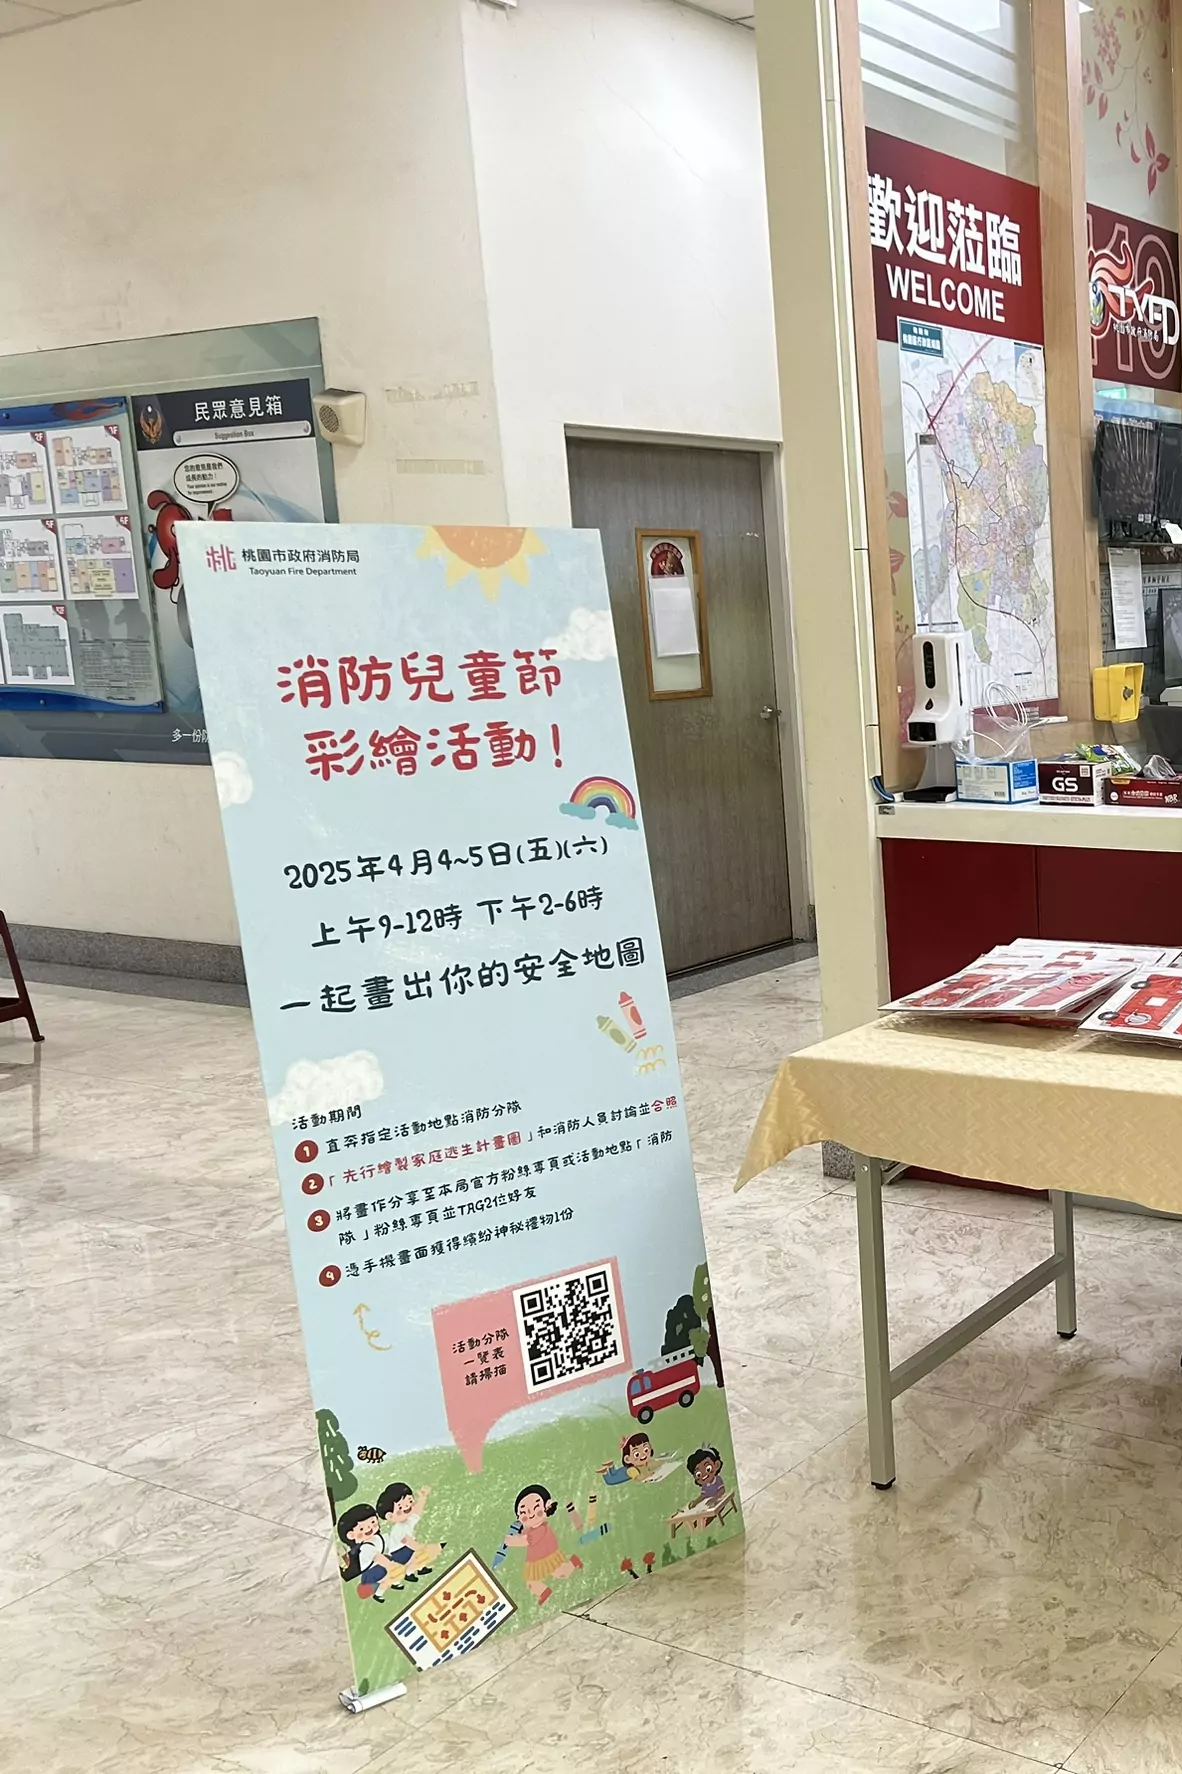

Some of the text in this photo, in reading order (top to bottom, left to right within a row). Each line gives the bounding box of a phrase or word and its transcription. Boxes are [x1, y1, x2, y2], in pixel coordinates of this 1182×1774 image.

[867, 172, 1022, 286] 歡迎蒞臨
[886, 263, 1006, 323] WELCOME
[195, 394, 283, 423] 民眾意見箱
[214, 432, 244, 441] Suggestion
[241, 548, 360, 563] 桃園市政府消防局
[249, 566, 357, 577] Taoyuan Fire Department
[276, 648, 562, 708] 消防兒童節
[1051, 776, 1079, 792] GS
[280, 936, 645, 1014] 一起畫出你的安全地圖
[291, 1104, 362, 1131] 活動期間
[451, 1328, 510, 1354] 活動分隊
[465, 1365, 508, 1387] 請掃描
